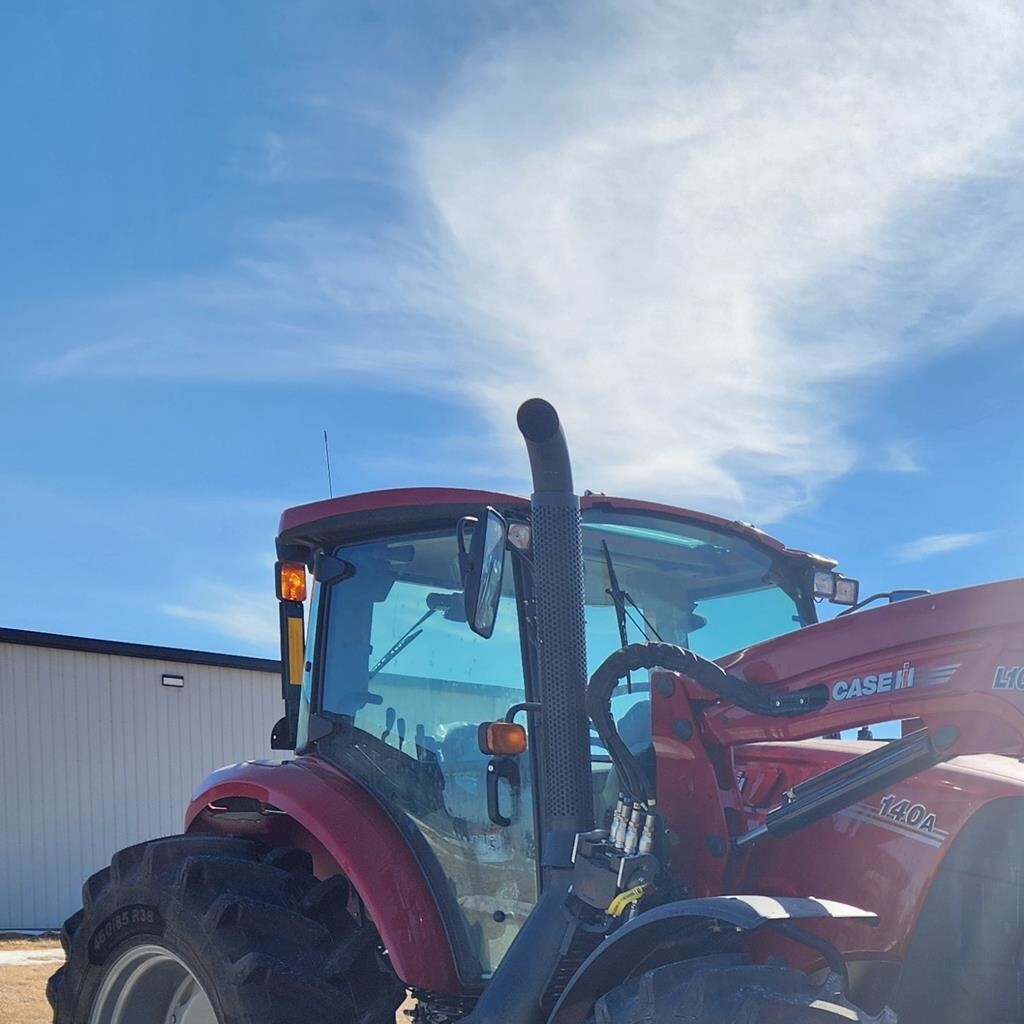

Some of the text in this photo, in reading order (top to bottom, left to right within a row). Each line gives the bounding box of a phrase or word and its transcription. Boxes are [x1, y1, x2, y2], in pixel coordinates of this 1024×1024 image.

[832, 672, 893, 701] CASE
[878, 794, 937, 832] 140A
[131, 909, 155, 923] R38
